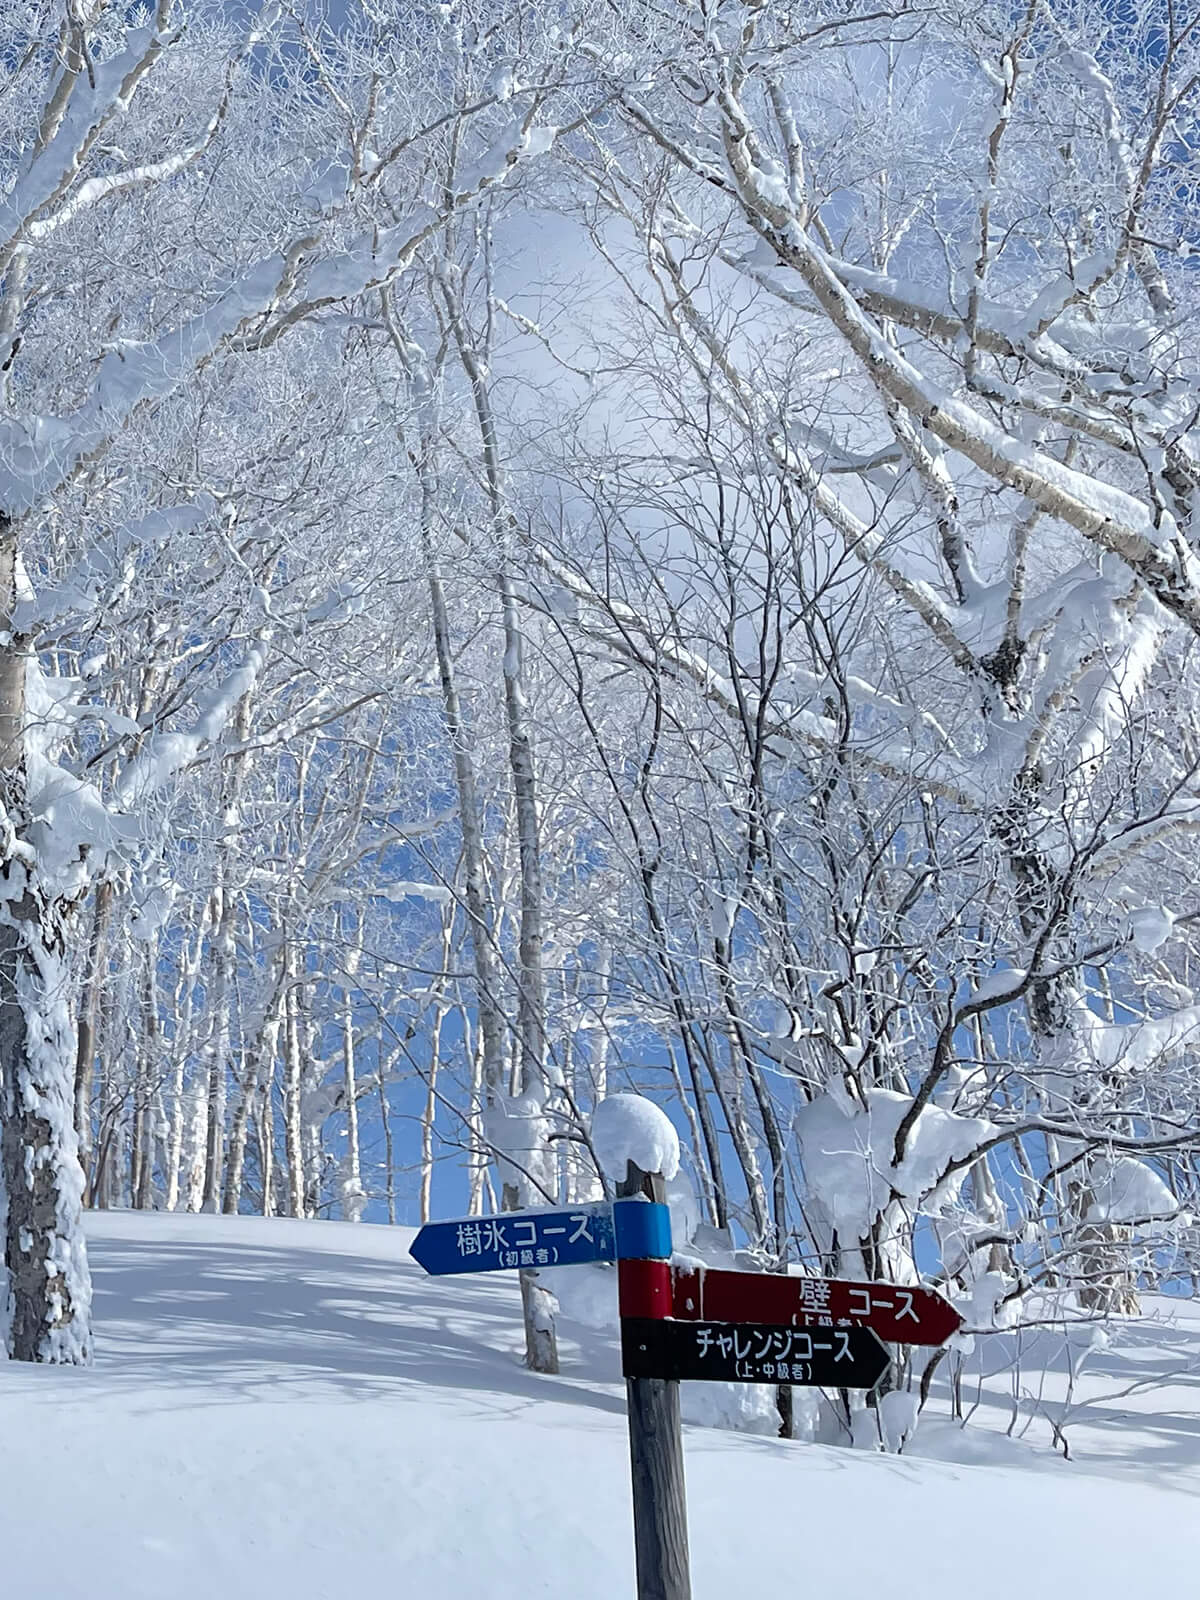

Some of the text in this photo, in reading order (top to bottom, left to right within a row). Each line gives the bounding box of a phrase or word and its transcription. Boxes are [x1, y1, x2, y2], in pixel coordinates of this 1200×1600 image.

[456, 1215, 595, 1257] 樹氷コース
[498, 1246, 559, 1267] (初級者)
[696, 1329, 855, 1363] チャレンジコース
